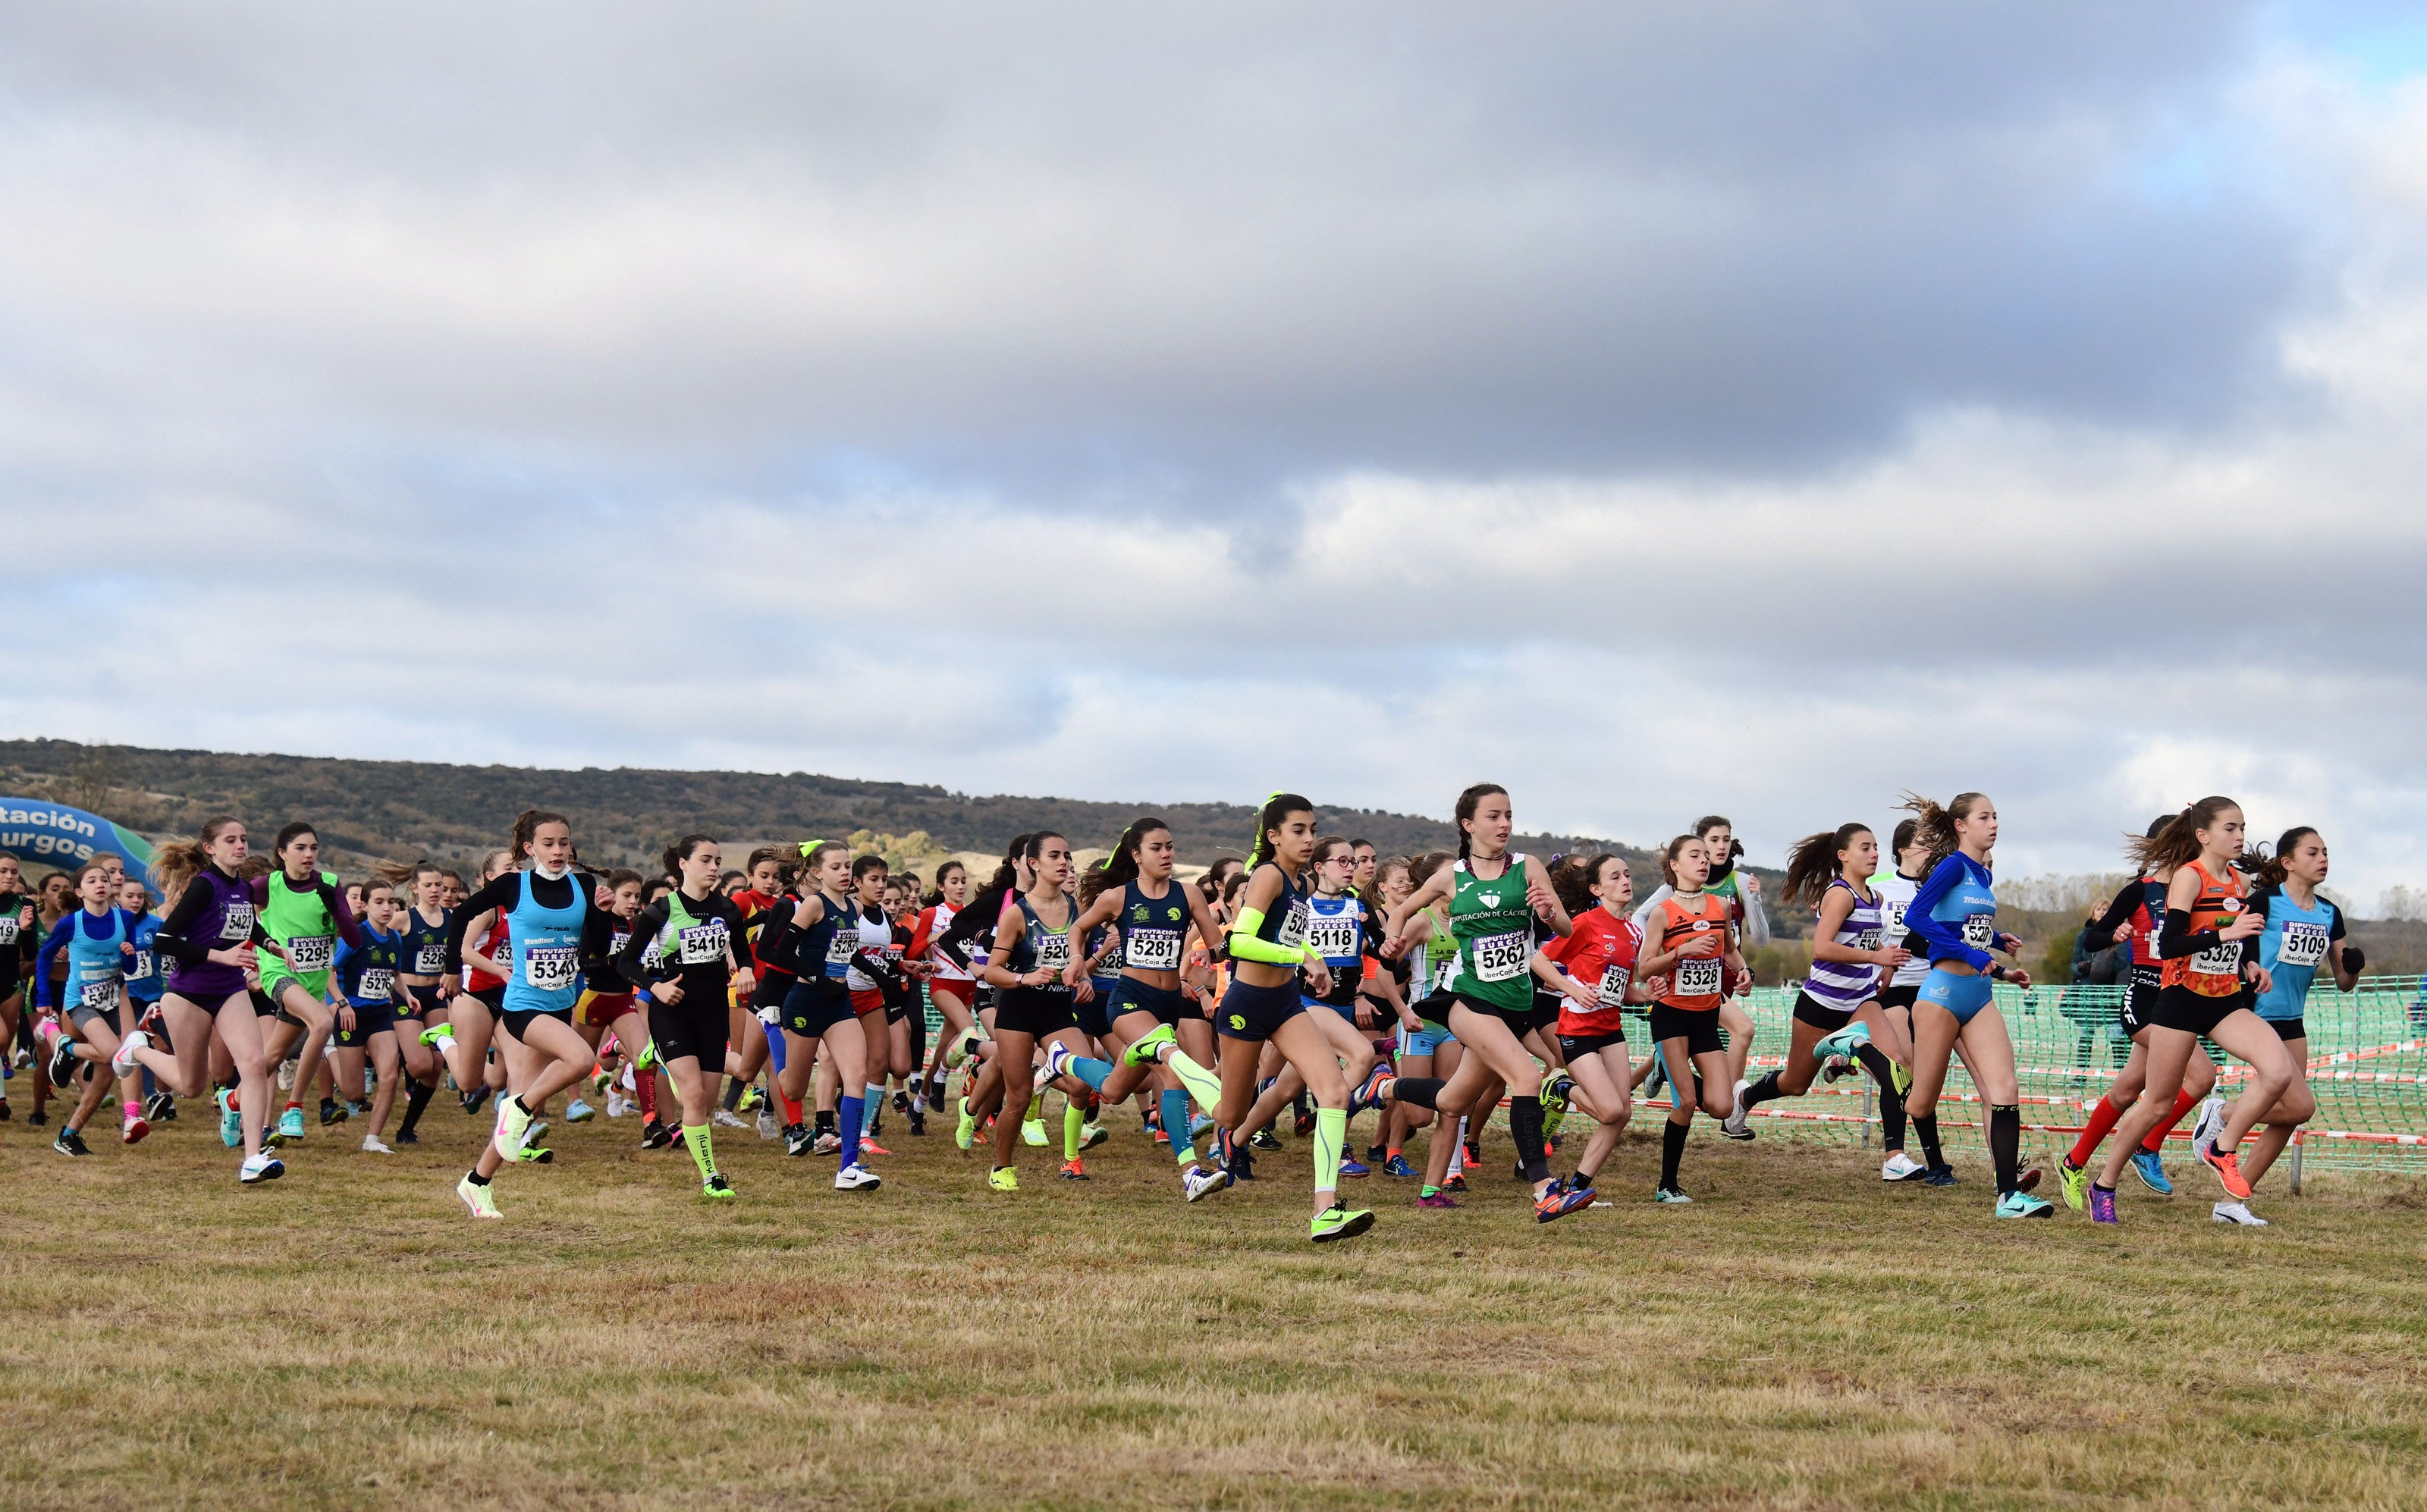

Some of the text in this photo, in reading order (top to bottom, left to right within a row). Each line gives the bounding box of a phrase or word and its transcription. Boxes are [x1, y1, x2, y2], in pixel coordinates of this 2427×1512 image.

[0, 806, 95, 837] tación
[2, 832, 94, 861] urgos
[229, 914, 251, 929] 5423
[1308, 918, 1352, 926] DIPUTACIÓN
[1452, 911, 1490, 923] DIPUTACIÓN
[684, 923, 724, 933] DIPUTACIÓN
[685, 927, 726, 939] BURGOS
[1134, 928, 1178, 936] DIPUTACIÓN
[2288, 921, 2327, 931] DIPUTACIÓN
[2288, 927, 2328, 936] BURGOS
[688, 934, 726, 953] 5416
[1311, 930, 1352, 946] 5118
[1478, 930, 1524, 945] DIPUTACIÓN
[1478, 935, 1525, 951] BURGOS
[2288, 934, 2325, 955] 5109
[295, 946, 329, 962] 5295
[497, 946, 513, 960] 53
[1134, 940, 1173, 957] 5281
[1483, 943, 1525, 968] 5262
[2200, 944, 2238, 962] 5329
[1132, 958, 1159, 966] iberCaja
[1682, 957, 1719, 965] DIPUTACIÓN
[2284, 954, 2309, 963] iberCaja
[534, 960, 575, 979] 5340
[1484, 969, 1514, 979] iberCaja
[2196, 961, 2224, 973] iberCaja
[366, 977, 391, 990] 5276
[1681, 969, 1718, 986] 5328
[1606, 975, 1625, 996] 521
[1680, 987, 1706, 995] iberCaja
[1601, 993, 1620, 1003] iberCaja
[695, 1134, 714, 1174] kalenji
